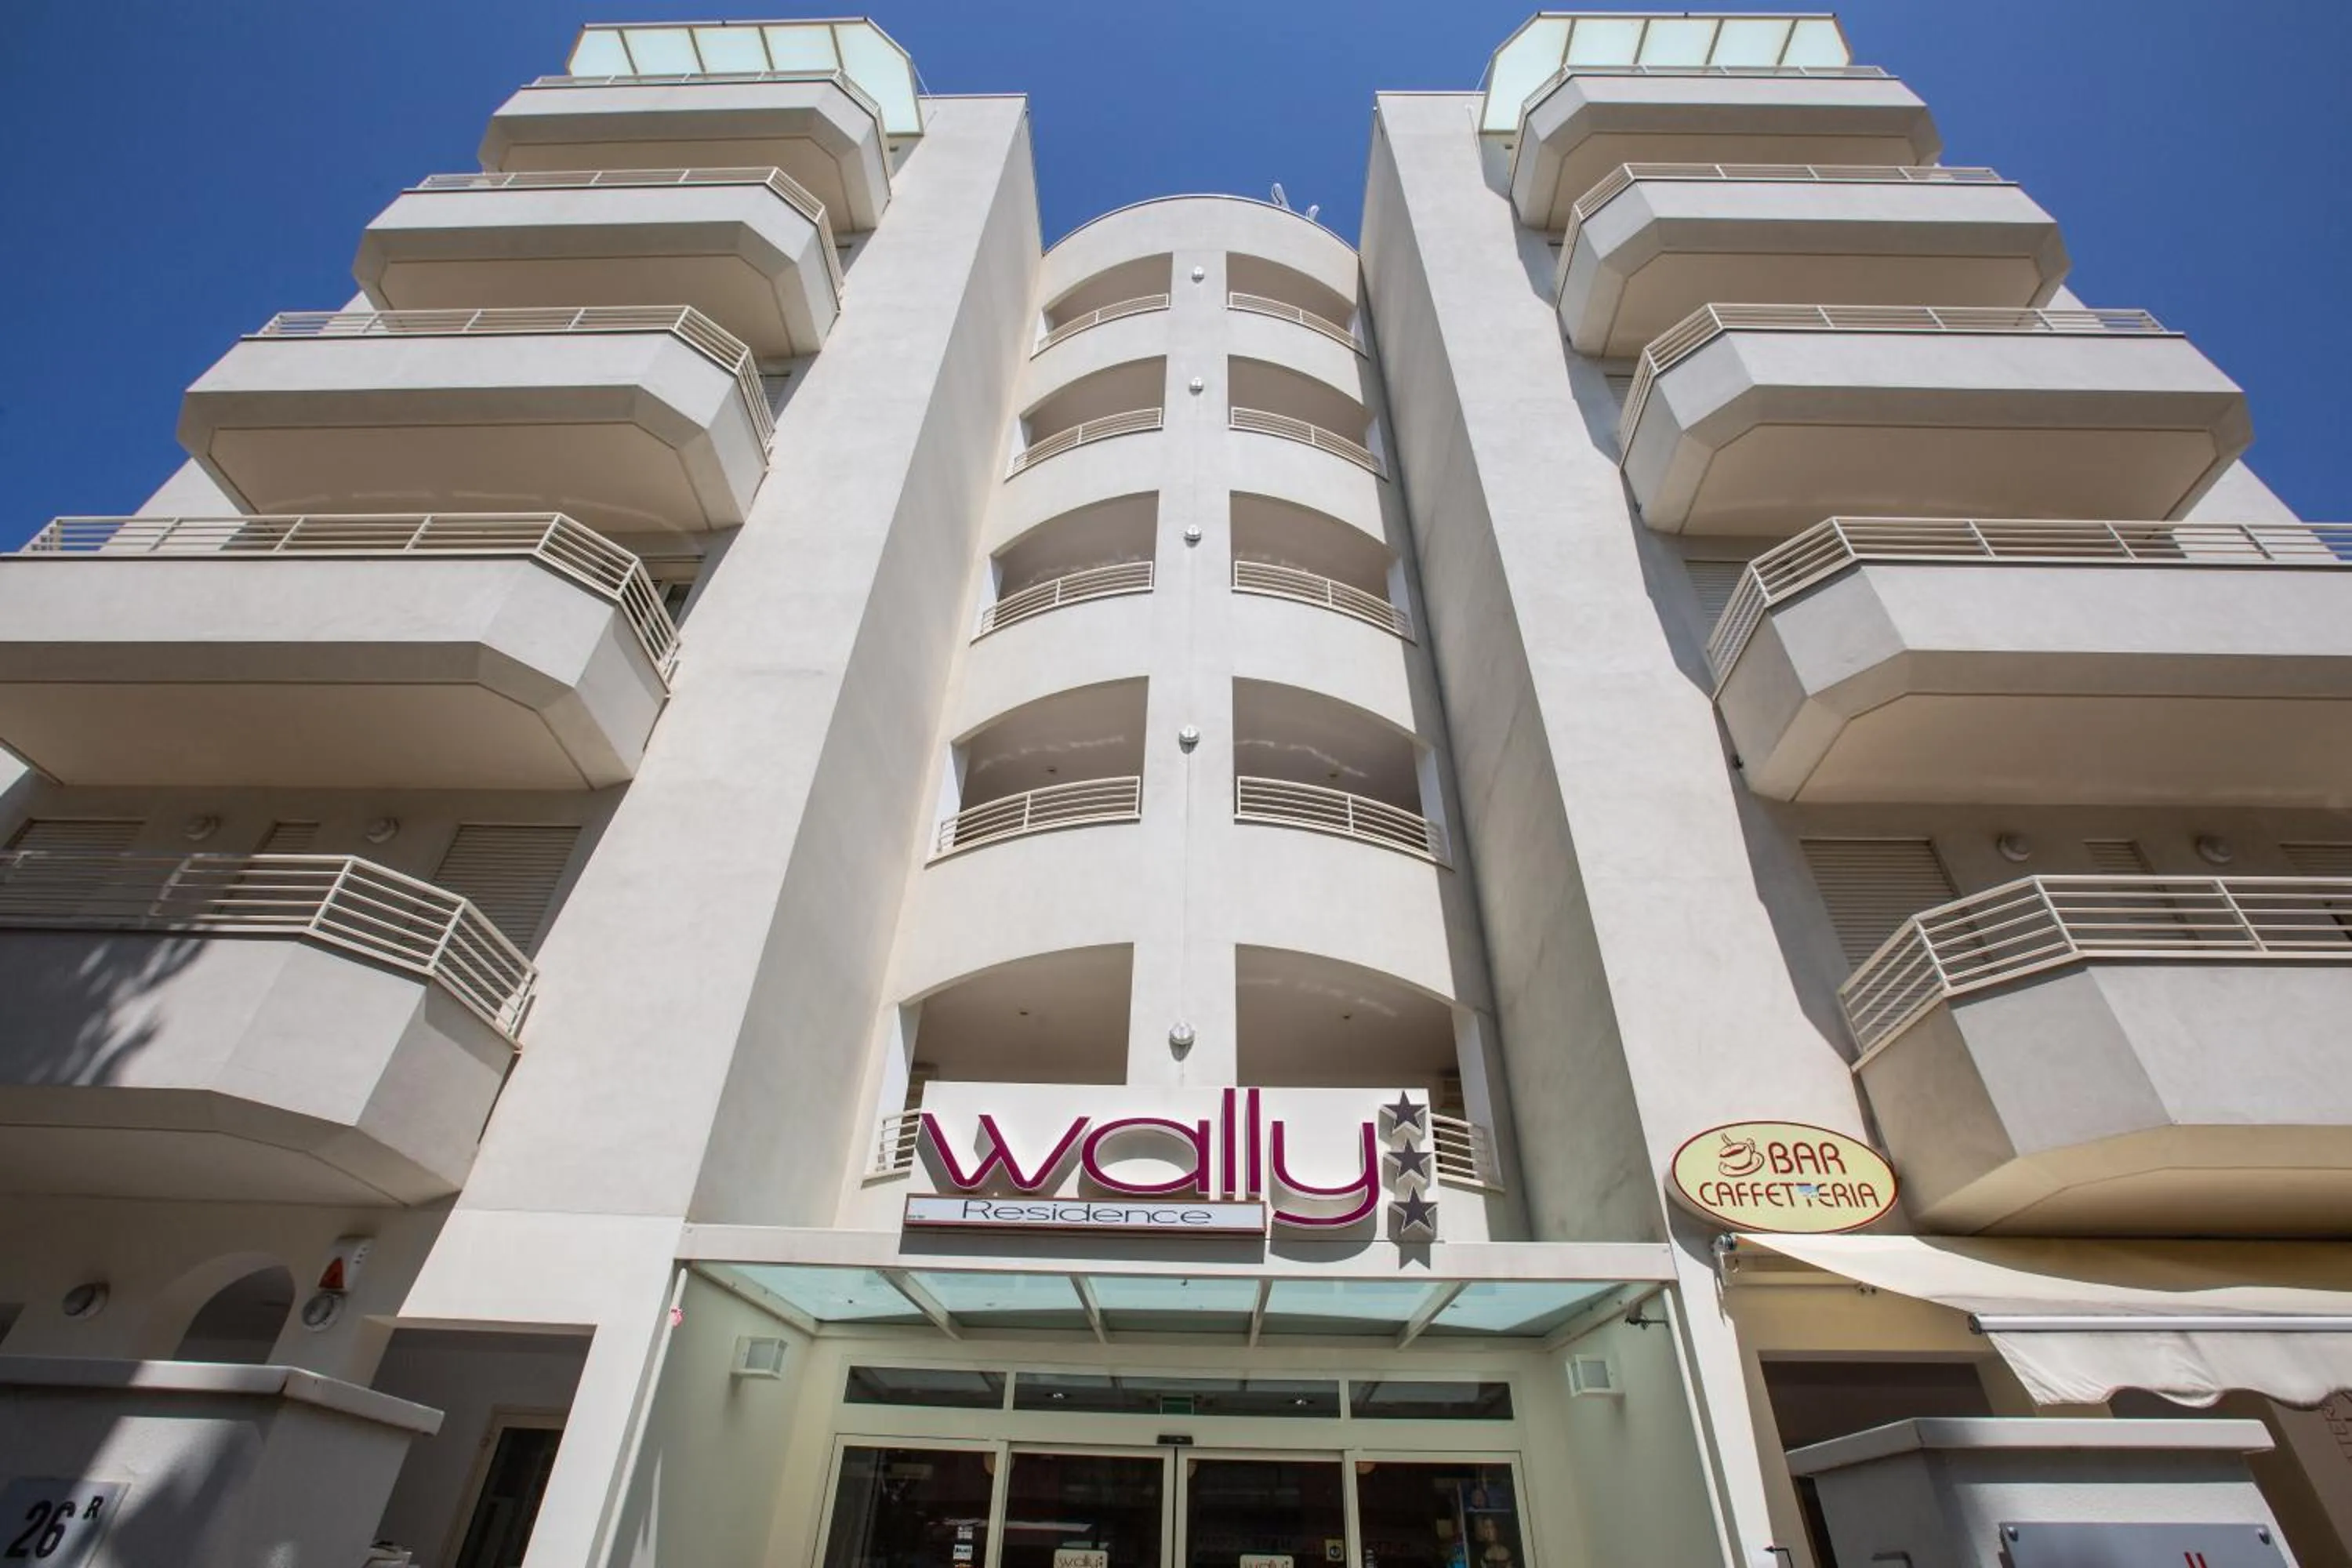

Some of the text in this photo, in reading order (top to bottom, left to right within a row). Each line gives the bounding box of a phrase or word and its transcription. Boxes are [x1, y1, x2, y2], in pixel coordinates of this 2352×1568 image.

[921, 1088, 1380, 1225] wally
[1768, 1142, 1847, 1174] BAR
[962, 1200, 1212, 1225] Residence
[4, 1500, 76, 1559] 26
